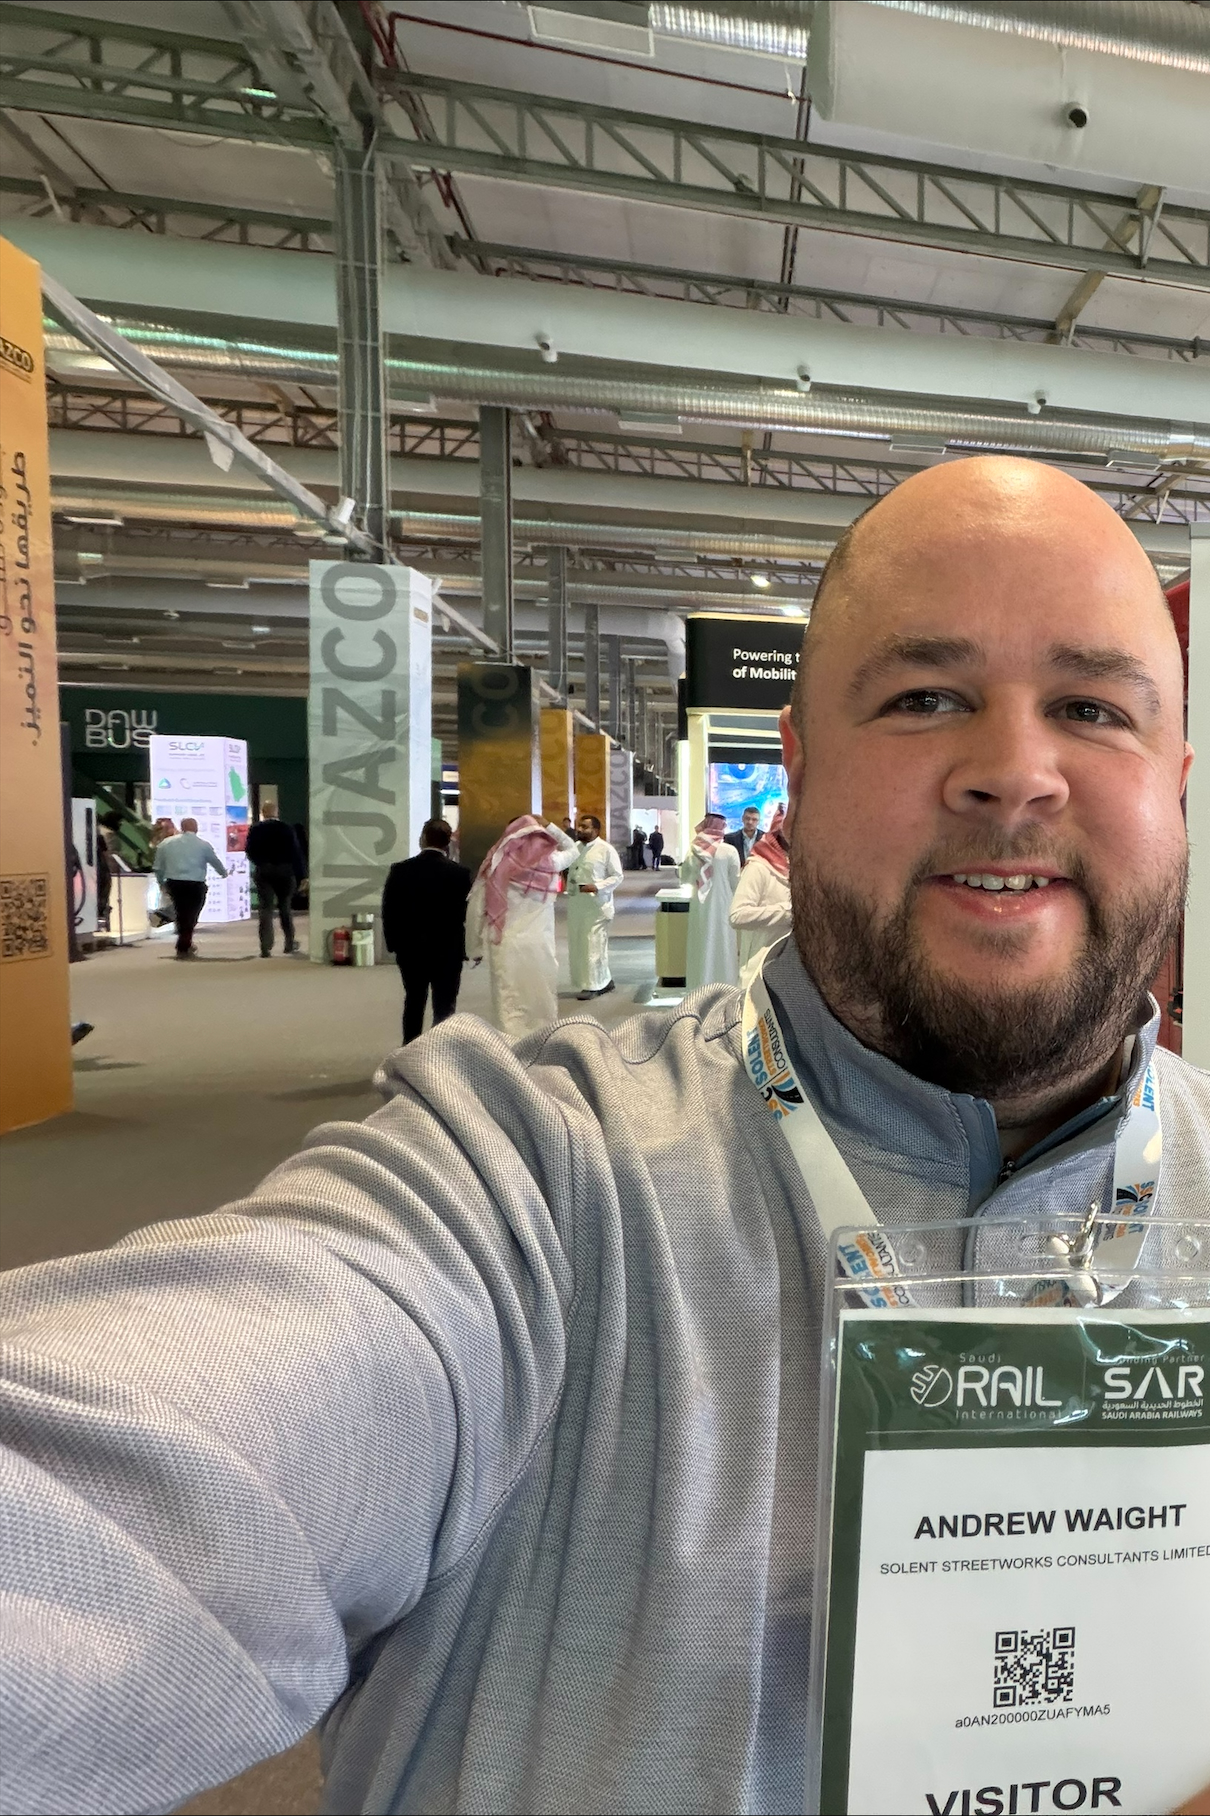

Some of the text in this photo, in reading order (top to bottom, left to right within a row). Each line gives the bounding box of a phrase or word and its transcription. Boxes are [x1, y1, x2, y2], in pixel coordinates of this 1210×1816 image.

[14, 577, 36, 634] نحو
[733, 648, 792, 665] Powering
[733, 667, 798, 681] of Mobilit
[320, 561, 397, 920] NJAZCO
[763, 1008, 786, 1069] CONSULTANTS
[747, 1026, 768, 1086] SOLENT
[960, 1352, 1001, 1363] Saudi
[1163, 1354, 1205, 1363] Partner
[957, 1365, 1062, 1407] RAIL
[1104, 1365, 1204, 1399] SAR
[956, 1409, 1062, 1420] International
[1102, 1398, 1204, 1411] الخطوط الحديدية السعودية
[1102, 1409, 1203, 1420] SAUDI ARABIA RAILWAYS
[914, 1504, 1187, 1540] ANDREW WAIGHT
[880, 1560, 939, 1575] SOLENT
[941, 1555, 1053, 1572] STREETWORKS
[1057, 1550, 1160, 1568] CONSULTANTS
[925, 1776, 1123, 1815] VISITOR
